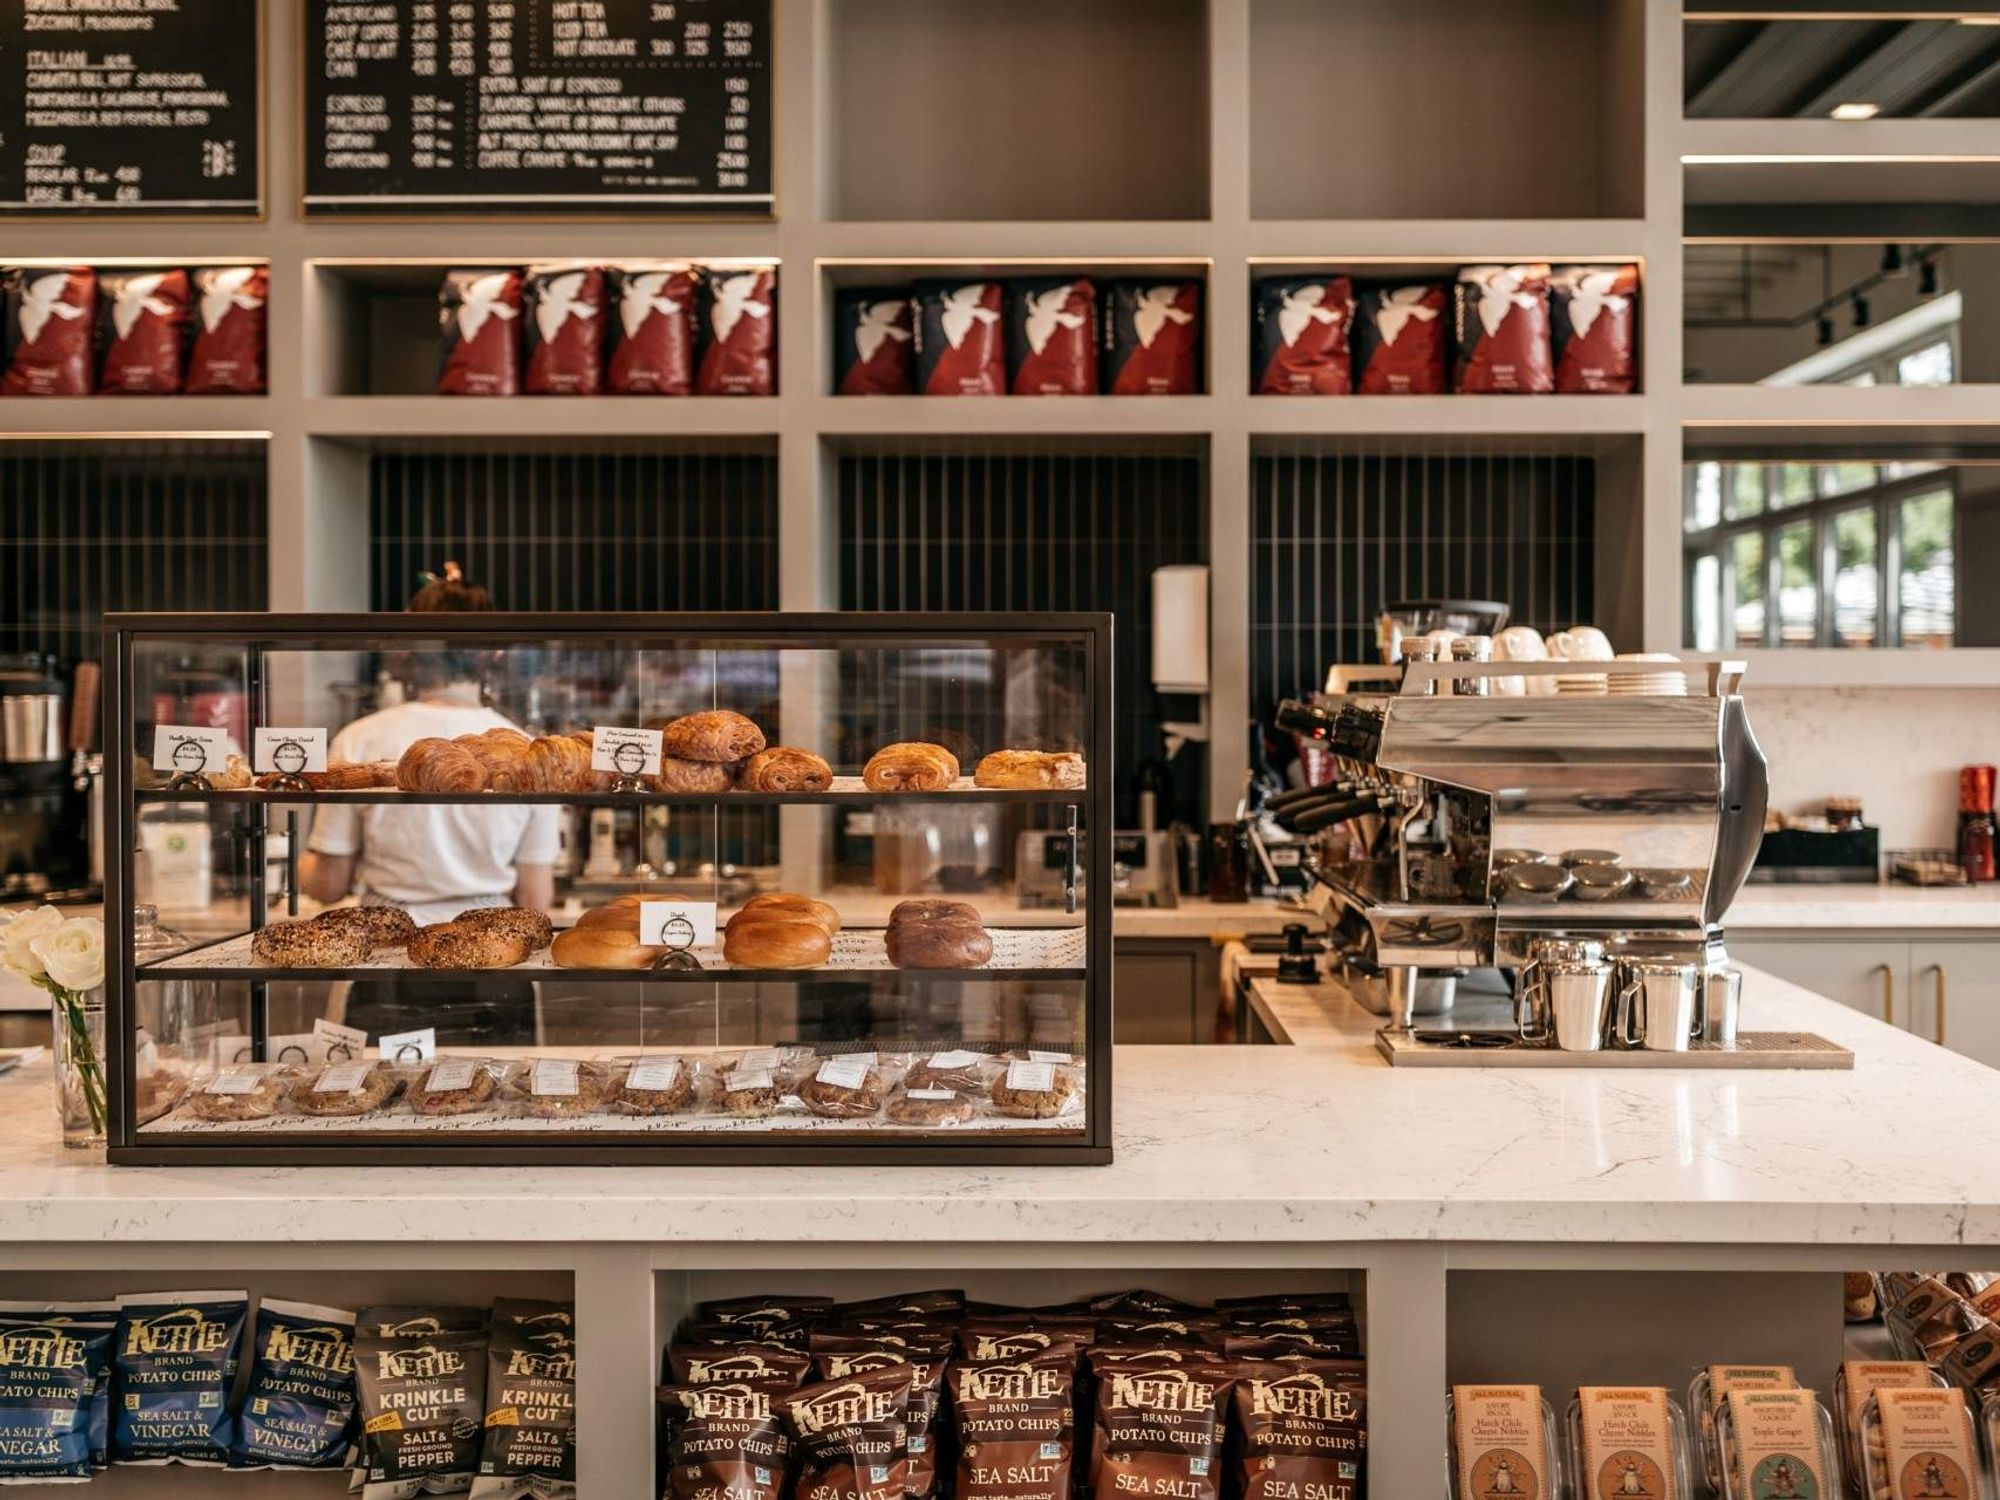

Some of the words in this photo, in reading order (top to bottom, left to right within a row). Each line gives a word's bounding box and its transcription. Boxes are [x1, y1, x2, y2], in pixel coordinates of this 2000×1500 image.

[122, 1308, 229, 1356] KETTLE
[154, 1357, 193, 1366] BRAND
[376, 1346, 465, 1379] KETTLE
[10, 1371, 50, 1380] BRAND
[128, 1371, 178, 1383] POTATO
[182, 1370, 221, 1382] CHIPS
[289, 1368, 327, 1382] BRAND
[405, 1378, 439, 1387] BRAND
[260, 1377, 310, 1394] POTATO
[313, 1385, 351, 1401] CHIPS
[530, 1379, 563, 1388] BRAND
[956, 1363, 1064, 1404] KETTLE
[1107, 1369, 1215, 1412] KETTLE
[37, 1387, 79, 1399] CHIPS
[379, 1388, 465, 1409] KRINKLE
[1247, 1373, 1358, 1422] KETTLE
[406, 1406, 440, 1422] CUT
[525, 1407, 559, 1421] CUT
[787, 1384, 898, 1438] KETTLE
[988, 1403, 1029, 1413] BRAND
[137, 1411, 159, 1421] SEA
[161, 1411, 191, 1421] SALT
[193, 1411, 203, 1421] &
[1141, 1413, 1182, 1424] BRAND
[13, 1427, 43, 1437] SALT
[45, 1428, 54, 1437] &
[130, 1423, 211, 1438] VINEGAR
[265, 1417, 285, 1430] SEA
[286, 1420, 316, 1435] SALT
[318, 1426, 328, 1437] &
[708, 1423, 750, 1432] BRAND
[962, 1420, 1014, 1433] POTATO
[1018, 1419, 1060, 1430] CHIPS
[1285, 1419, 1325, 1431] BRAND
[826, 1427, 862, 1443] BRAND
[1111, 1428, 1166, 1442] POTATO
[1169, 1430, 1211, 1445] CHIPS
[1256, 1433, 1312, 1446] POTATO
[1315, 1436, 1356, 1450] CHIPS
[422, 1443, 452, 1452] GROUND
[532, 1445, 563, 1453] GROUND
[684, 1438, 734, 1454] POTATO
[738, 1439, 773, 1456] CHIPS
[855, 1441, 891, 1454] CHIPS
[398, 1451, 454, 1468] PEPPER
[507, 1453, 562, 1468] PEPPER
[970, 1467, 1002, 1485] SEA
[1007, 1466, 1053, 1484] SALT
[1115, 1473, 1150, 1493] SEA
[1154, 1476, 1201, 1499] SALT
[1263, 1480, 1300, 1499] SEA
[1305, 1483, 1350, 1500] SALT
